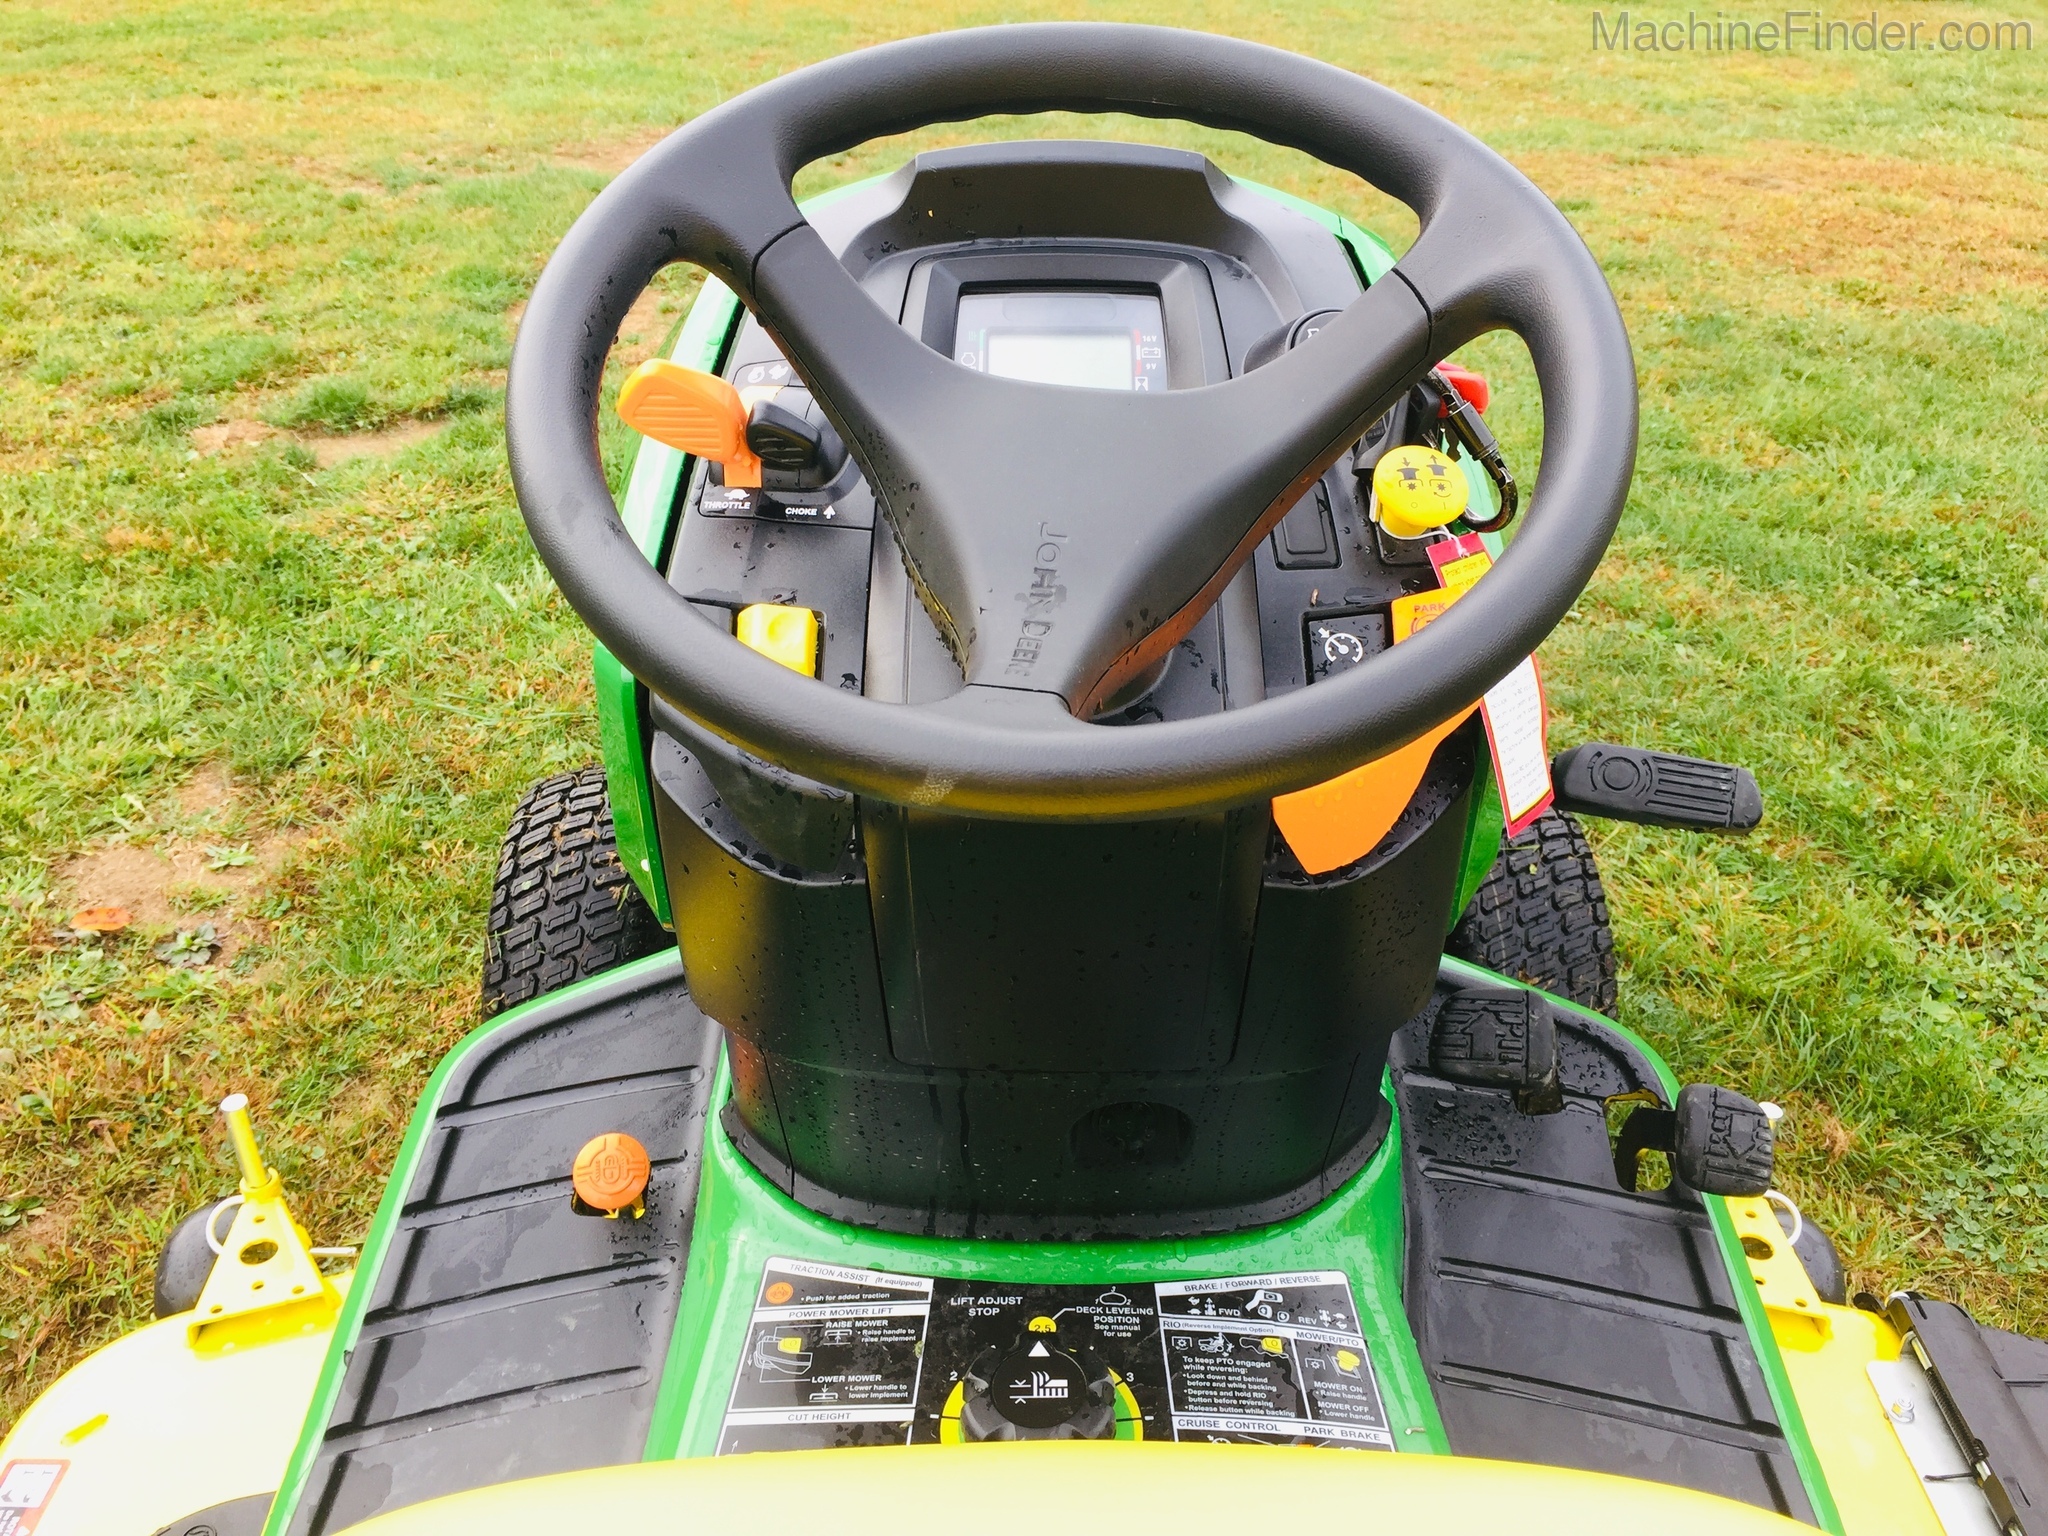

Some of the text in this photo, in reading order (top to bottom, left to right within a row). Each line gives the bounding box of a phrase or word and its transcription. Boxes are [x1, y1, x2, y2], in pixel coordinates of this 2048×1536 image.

[704, 501, 751, 510] THROTTLE
[785, 507, 818, 516] CHOKE
[1414, 602, 1446, 613] PARK
[790, 1263, 836, 1277] TRACTION
[837, 1271, 870, 1282] ASSIST
[884, 1278, 923, 1287] equipped)
[1184, 1283, 1219, 1292] BRAKE
[1225, 1278, 1272, 1288] FORWARD
[1280, 1275, 1321, 1285] REVERSE
[950, 1296, 1023, 1305] LIFT ADJUST
[789, 1307, 893, 1318] POWER MOWER LIFT
[968, 1307, 1000, 1316] STOP
[1076, 1306, 1154, 1315] DECK LEVELING
[1218, 1308, 1241, 1316] FWD
[825, 1319, 888, 1329] RAISE MOWER
[1093, 1315, 1140, 1324] POSITION
[1298, 1316, 1317, 1325] REV
[1213, 1323, 1247, 1332] Implement
[1249, 1326, 1274, 1334] Option)
[1296, 1331, 1359, 1346] MOWER/PTO
[1195, 1357, 1215, 1365] keep
[1216, 1357, 1234, 1365] PTO
[1236, 1359, 1271, 1368] engaged
[847, 1374, 882, 1382] MOWER
[949, 1371, 958, 1381] 2
[1126, 1373, 1135, 1382] 3
[1243, 1375, 1268, 1383] behind
[1248, 1383, 1277, 1392] backing
[1314, 1381, 1363, 1393] MOWER ON
[1188, 1388, 1218, 1396] Depress
[1235, 1390, 1252, 1398] hold
[1253, 1391, 1267, 1399] RIO
[1342, 1392, 1367, 1401] handle
[1214, 1397, 1237, 1405] before
[1239, 1399, 1274, 1407] reversing
[1317, 1401, 1369, 1413] MOWER OFF
[1189, 1404, 1295, 1418] Release button while backing
[1324, 1410, 1375, 1421] Lower handle
[788, 1412, 851, 1421] CUT HEIGHT
[1178, 1419, 1281, 1431] CRUISE CONTROL
[1304, 1426, 1381, 1441] PARK BRAKE
